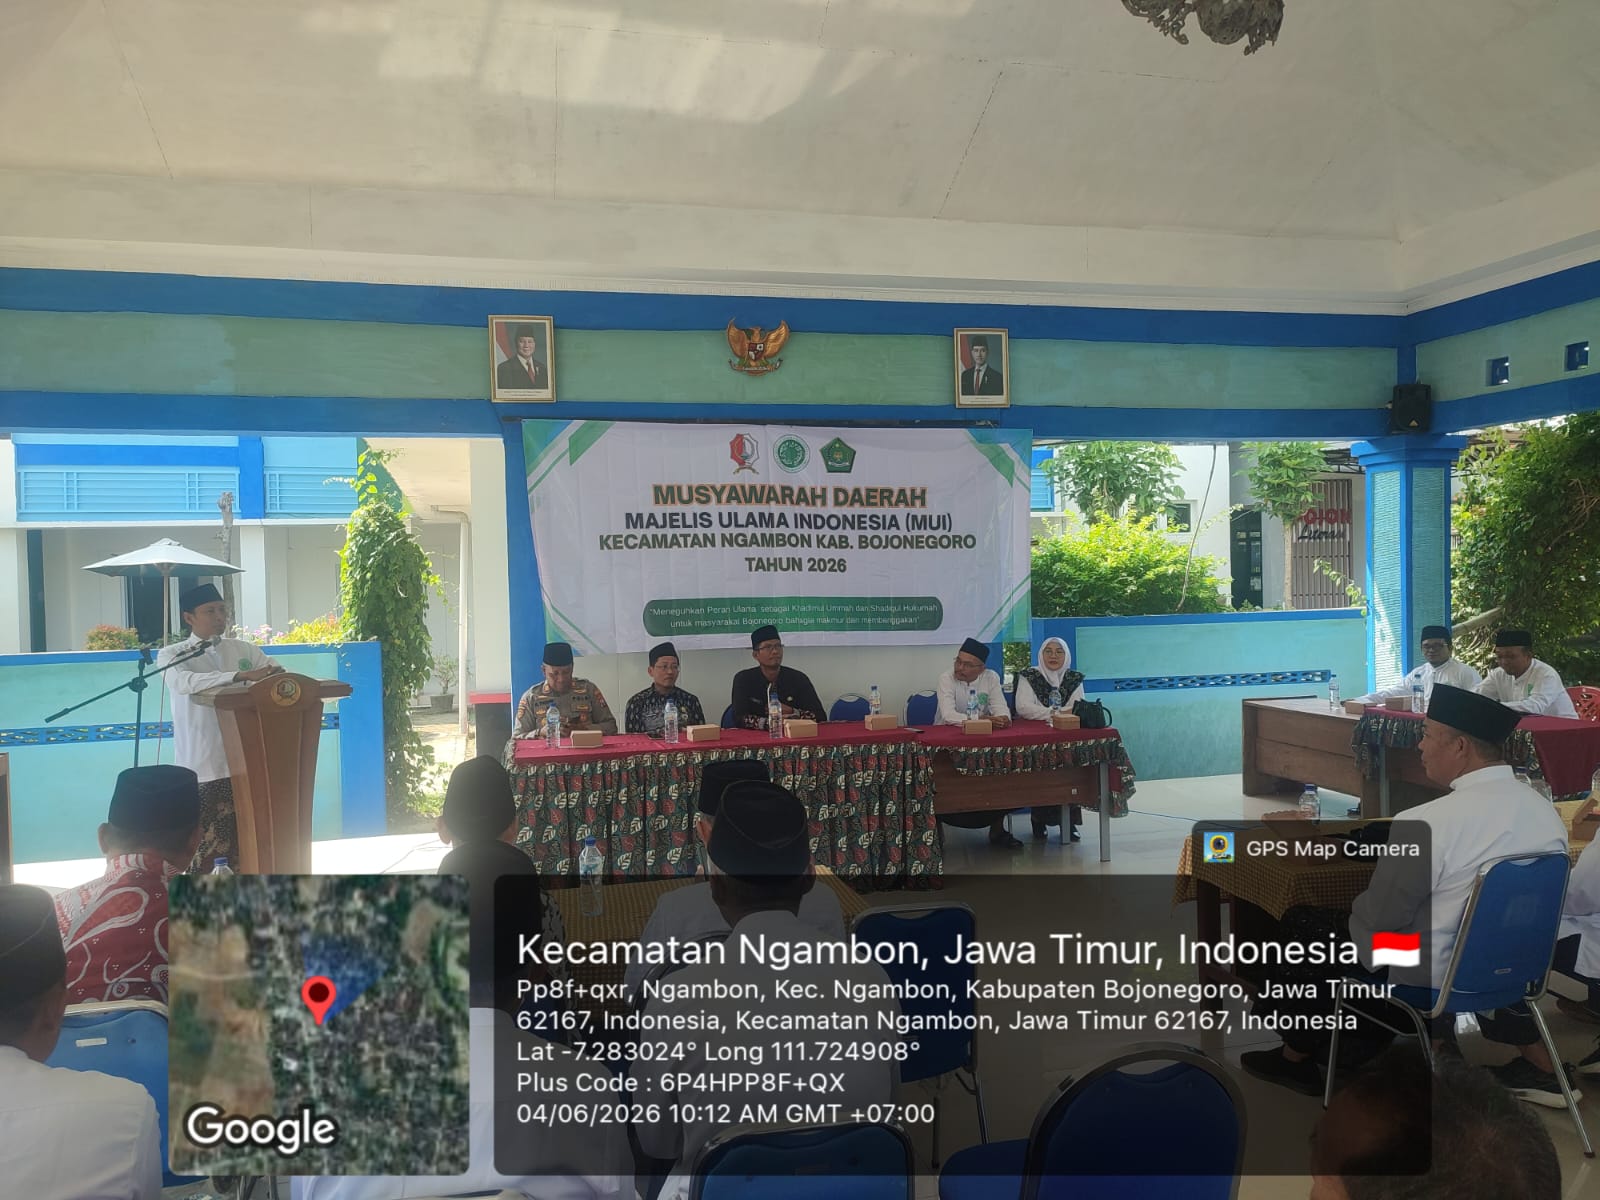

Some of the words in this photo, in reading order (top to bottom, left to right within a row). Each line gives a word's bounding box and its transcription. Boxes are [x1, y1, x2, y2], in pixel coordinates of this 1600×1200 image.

[652, 483, 828, 507] MUSYAWARAH
[832, 485, 928, 508] DAERAH
[625, 511, 713, 529] MAJELIS
[718, 511, 790, 529] ULAMA
[793, 513, 901, 531] INDONESIA
[905, 513, 953, 533] (MUI)
[599, 532, 717, 550] KECAMATAN
[720, 532, 812, 549] NGAMBON
[815, 534, 854, 550] KAB.
[858, 534, 977, 550] BOJONEGORO
[744, 556, 803, 573] TAHUN
[807, 557, 847, 573] 2026
[855, 603, 869, 612] dan
[670, 619, 692, 628] untuk
